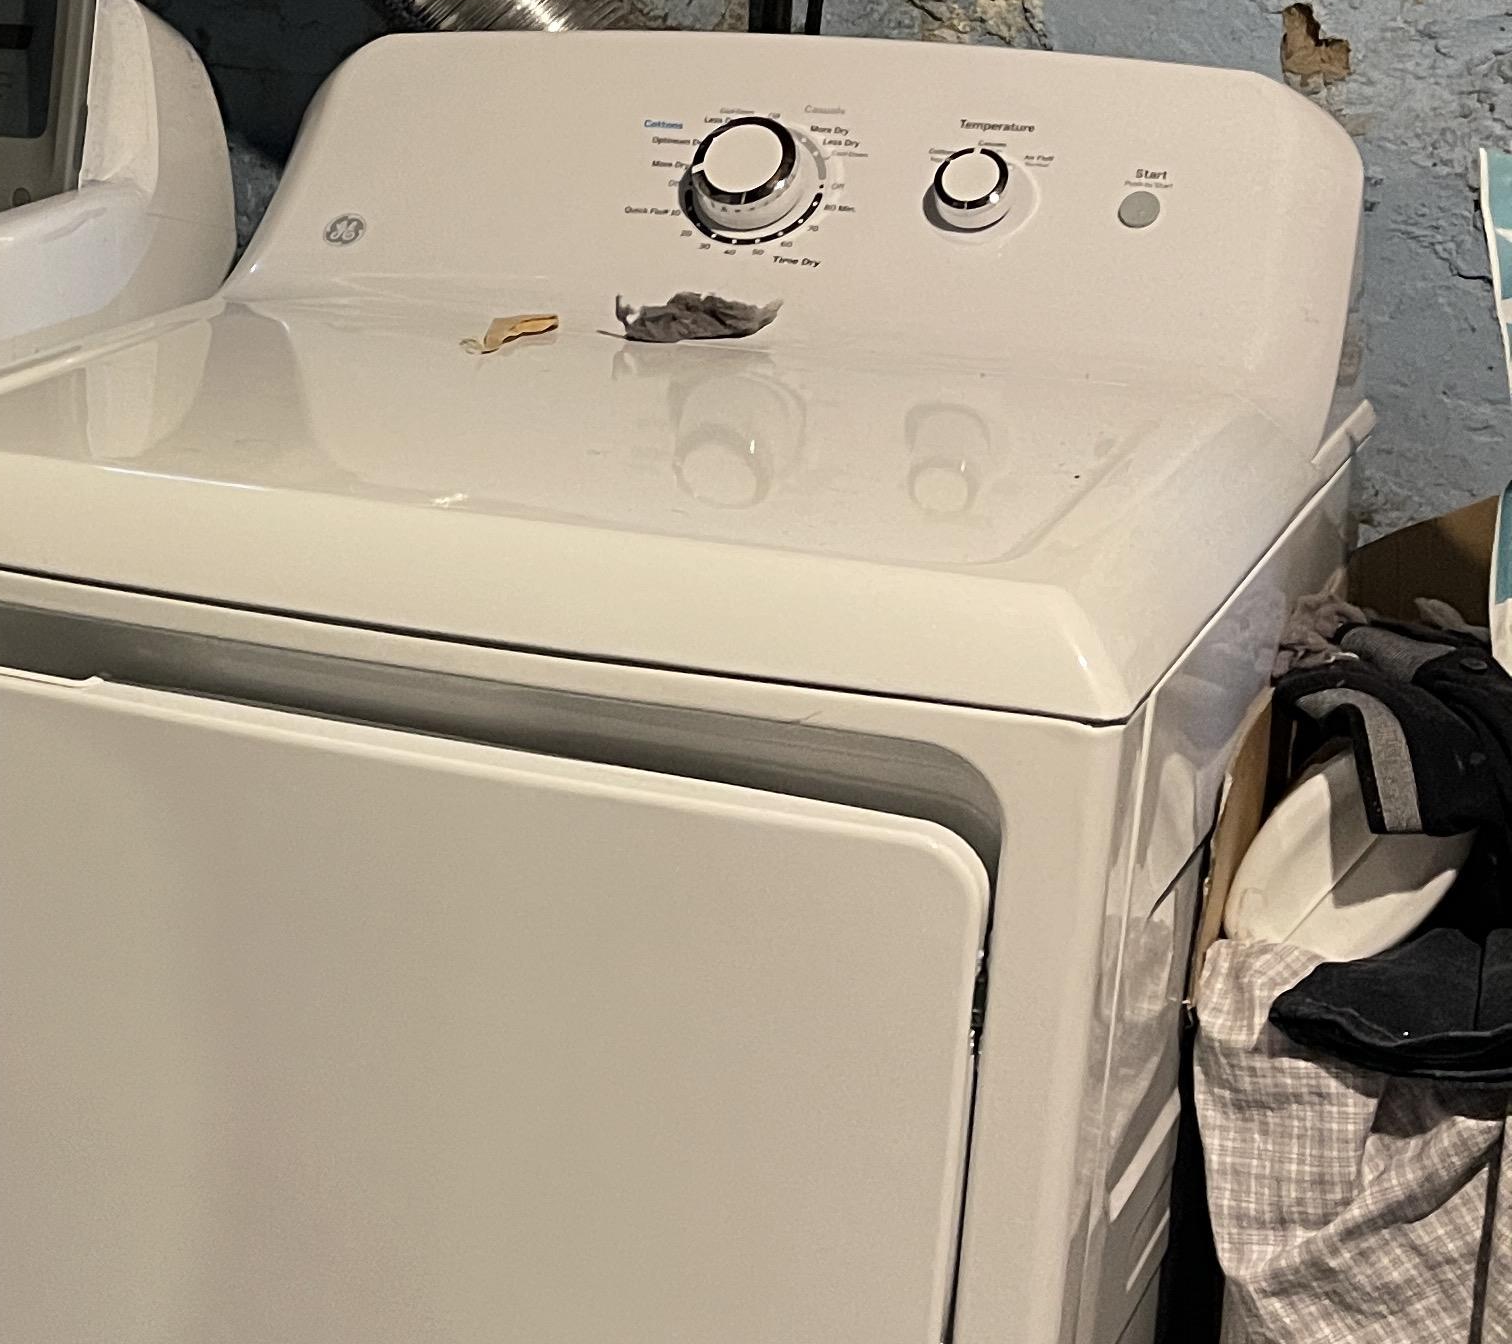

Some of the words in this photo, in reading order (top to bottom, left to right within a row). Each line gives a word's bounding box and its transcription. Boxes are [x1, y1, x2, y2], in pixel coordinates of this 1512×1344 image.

[644, 119, 684, 130] Cottons
[959, 118, 1036, 133] Temperature
[810, 125, 832, 135] More
[833, 126, 850, 137] Dry
[822, 137, 843, 147] Less
[843, 138, 861, 149] Dry
[1135, 168, 1168, 180] Start
[772, 255, 799, 266] Time
[801, 257, 822, 268] Dry
